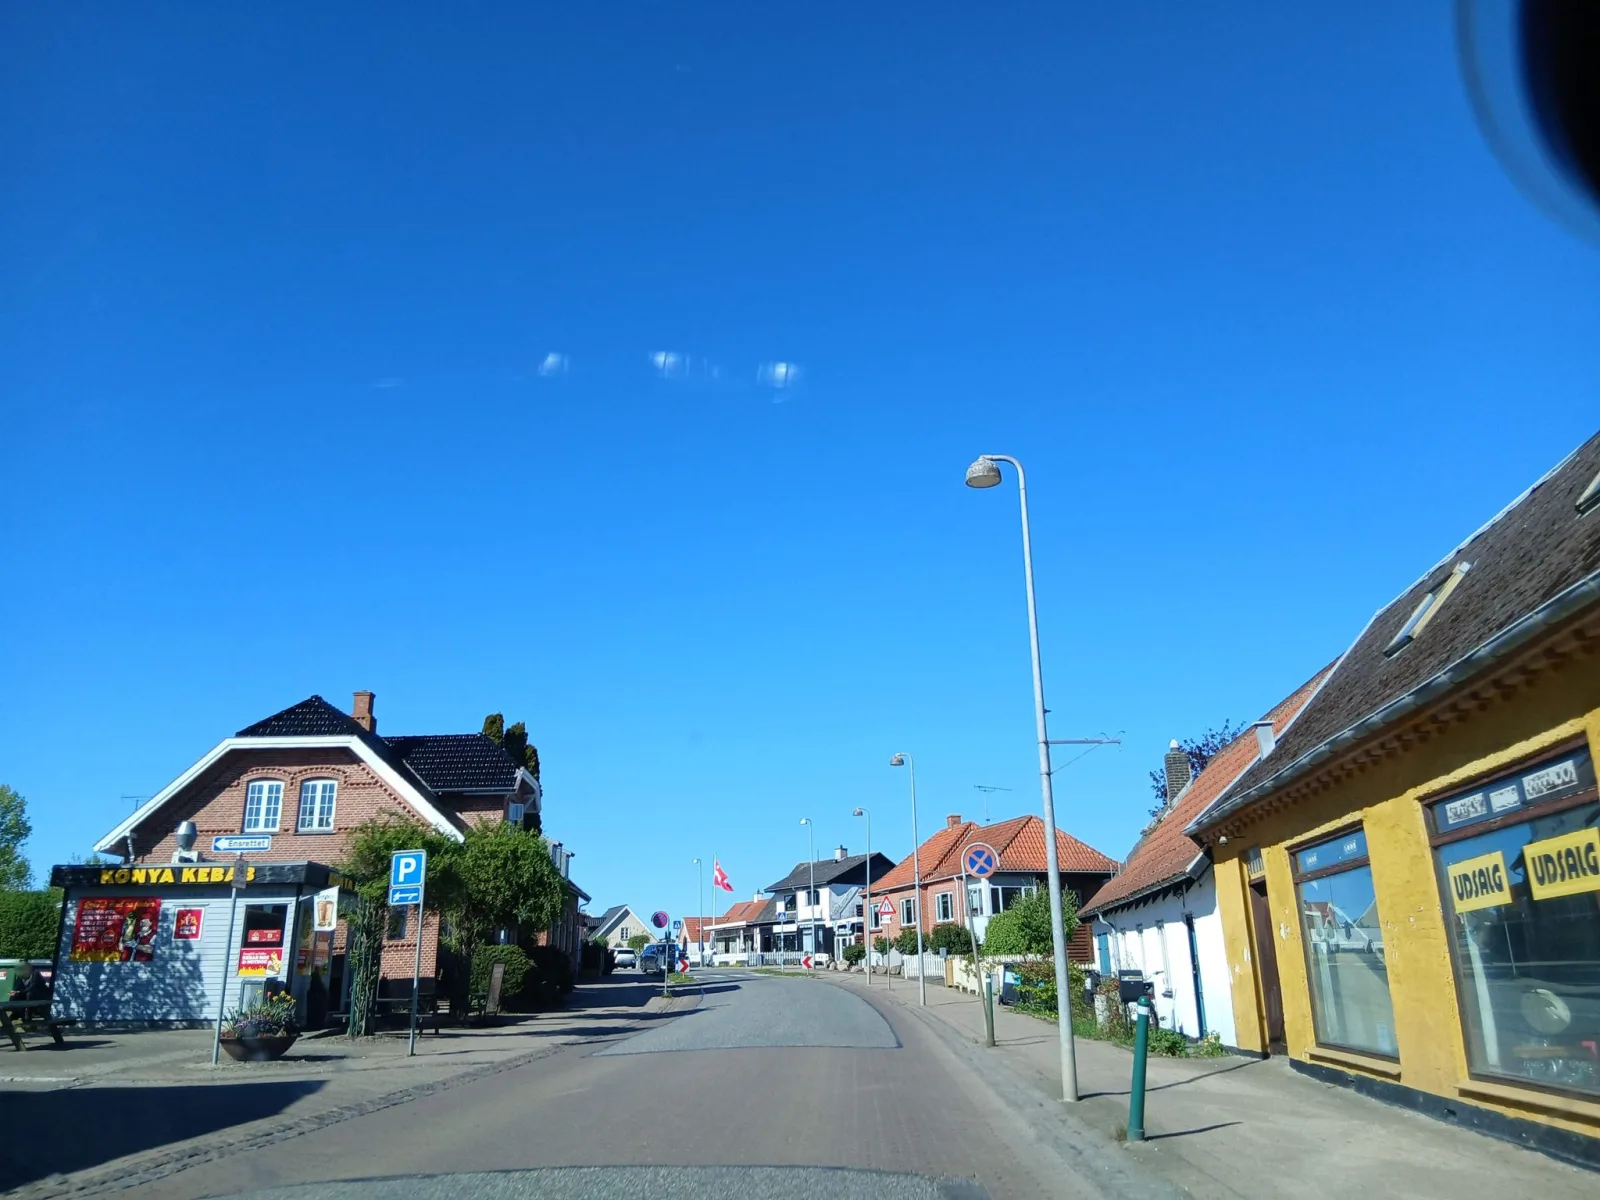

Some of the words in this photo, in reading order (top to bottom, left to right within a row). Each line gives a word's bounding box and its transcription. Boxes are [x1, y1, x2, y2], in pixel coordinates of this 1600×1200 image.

[100, 868, 175, 884] KONYA
[398, 857, 417, 883] P
[1531, 842, 1600, 887] UDSALG
[1453, 863, 1504, 902] UDSALG
